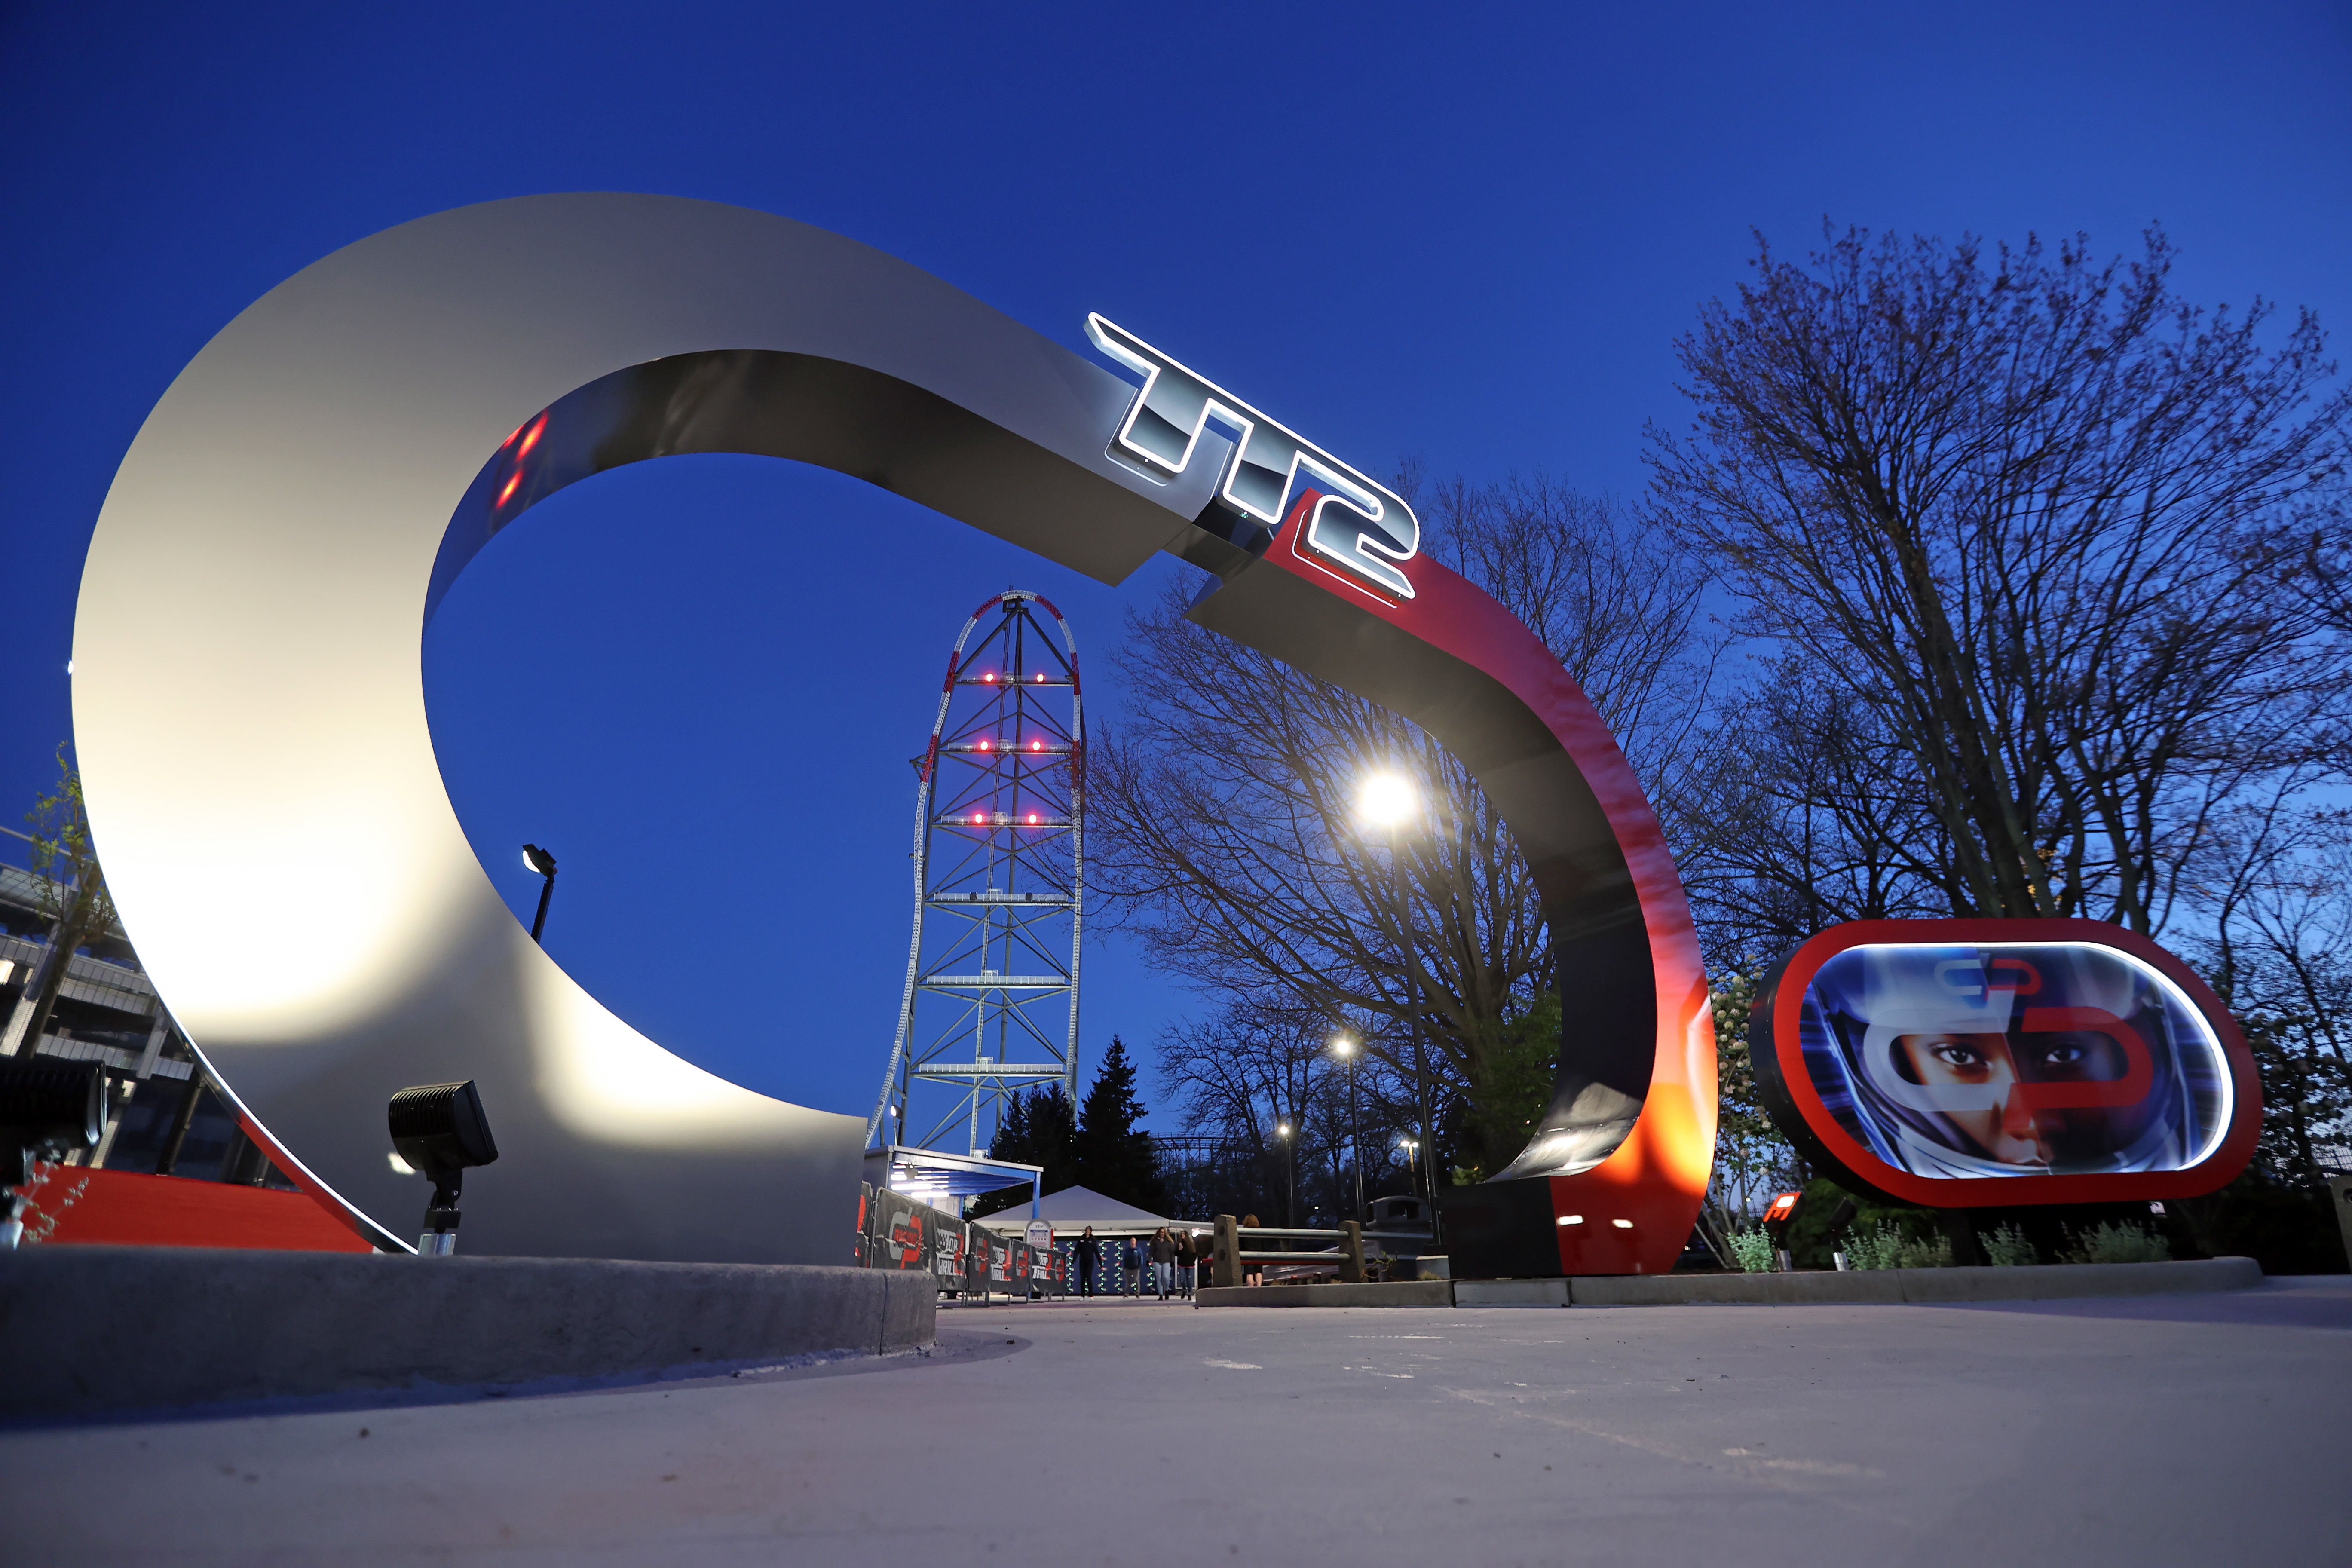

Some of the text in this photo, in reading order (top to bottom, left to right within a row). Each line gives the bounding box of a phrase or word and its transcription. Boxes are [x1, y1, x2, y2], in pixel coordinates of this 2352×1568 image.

[937, 1228, 958, 1253] TOP
[935, 1251, 957, 1276] THRILL
[992, 1246, 1005, 1264] TOP
[1035, 1251, 1048, 1266] TOP
